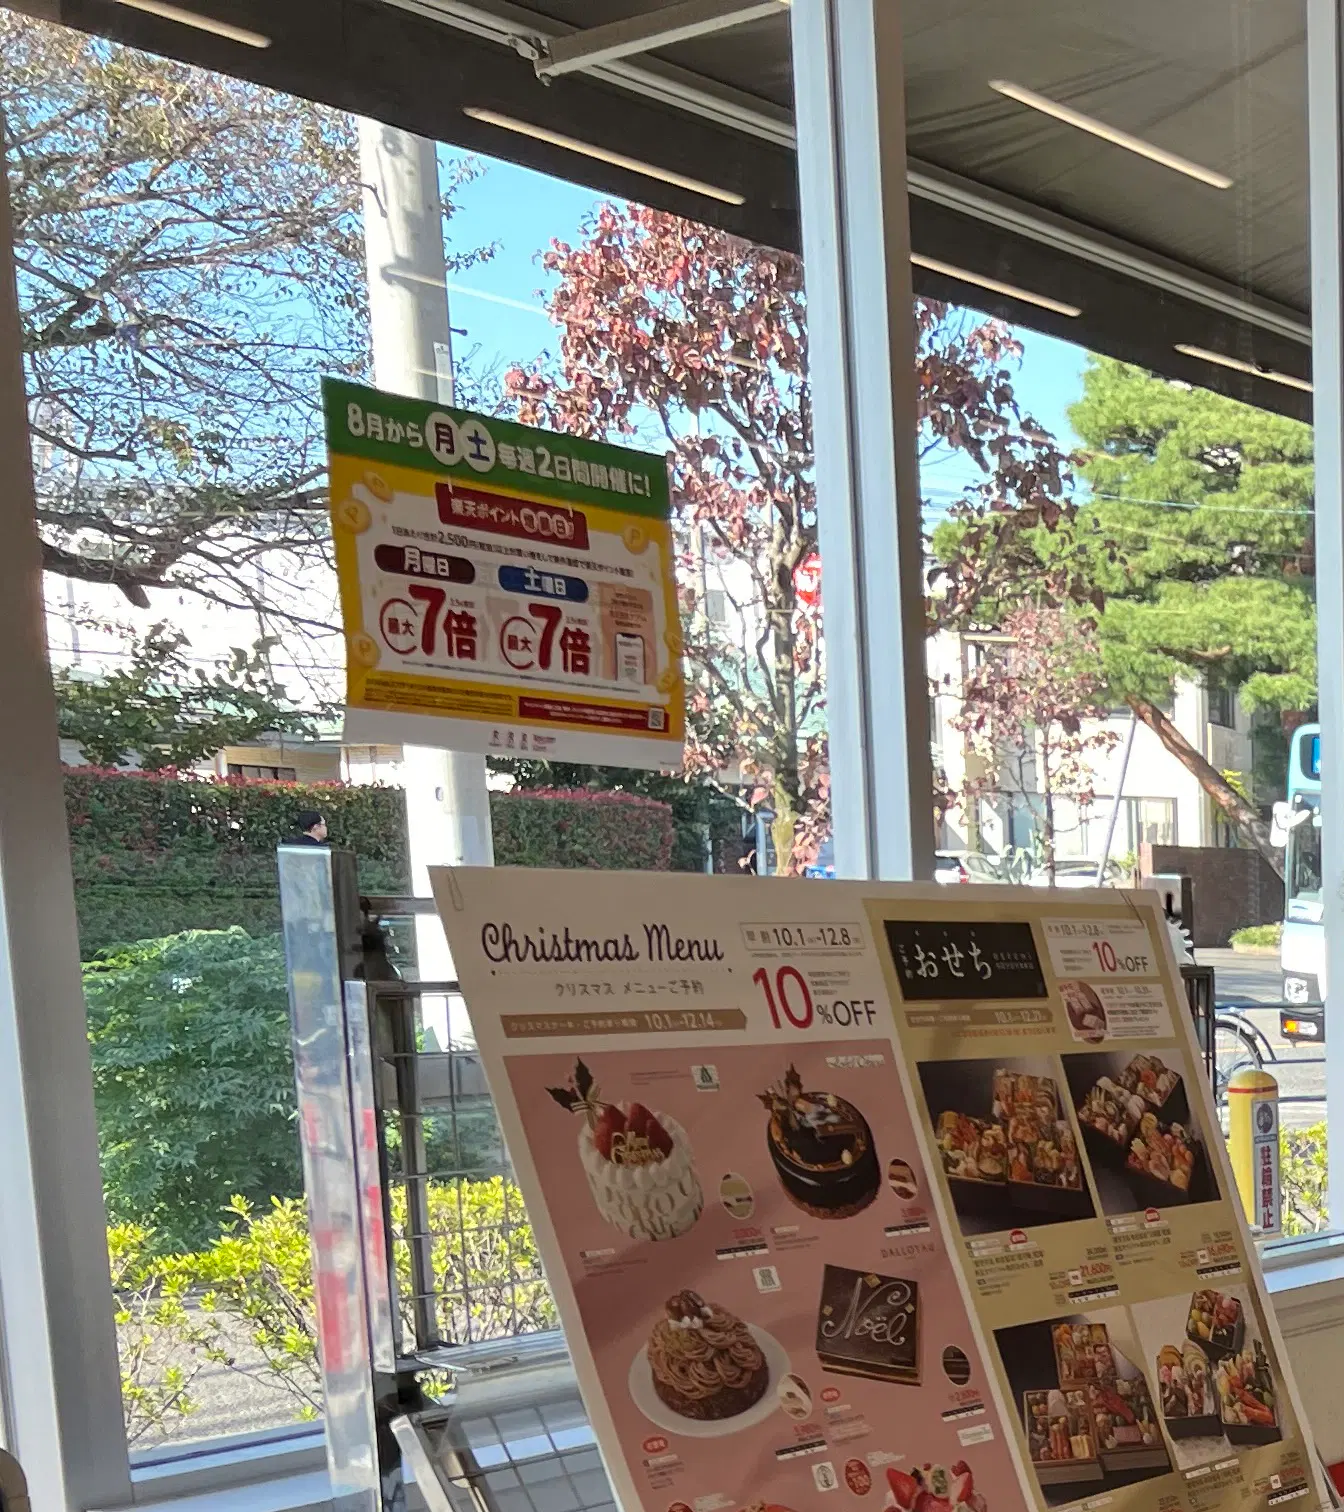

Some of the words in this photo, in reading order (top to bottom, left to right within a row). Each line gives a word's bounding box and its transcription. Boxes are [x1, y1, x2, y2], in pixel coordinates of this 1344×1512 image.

[482, 922, 640, 964] Christmas
[643, 923, 724, 963] Menu
[914, 941, 992, 980] おせち
[555, 982, 616, 997] クリスマス
[821, 1277, 912, 1346] Noël
